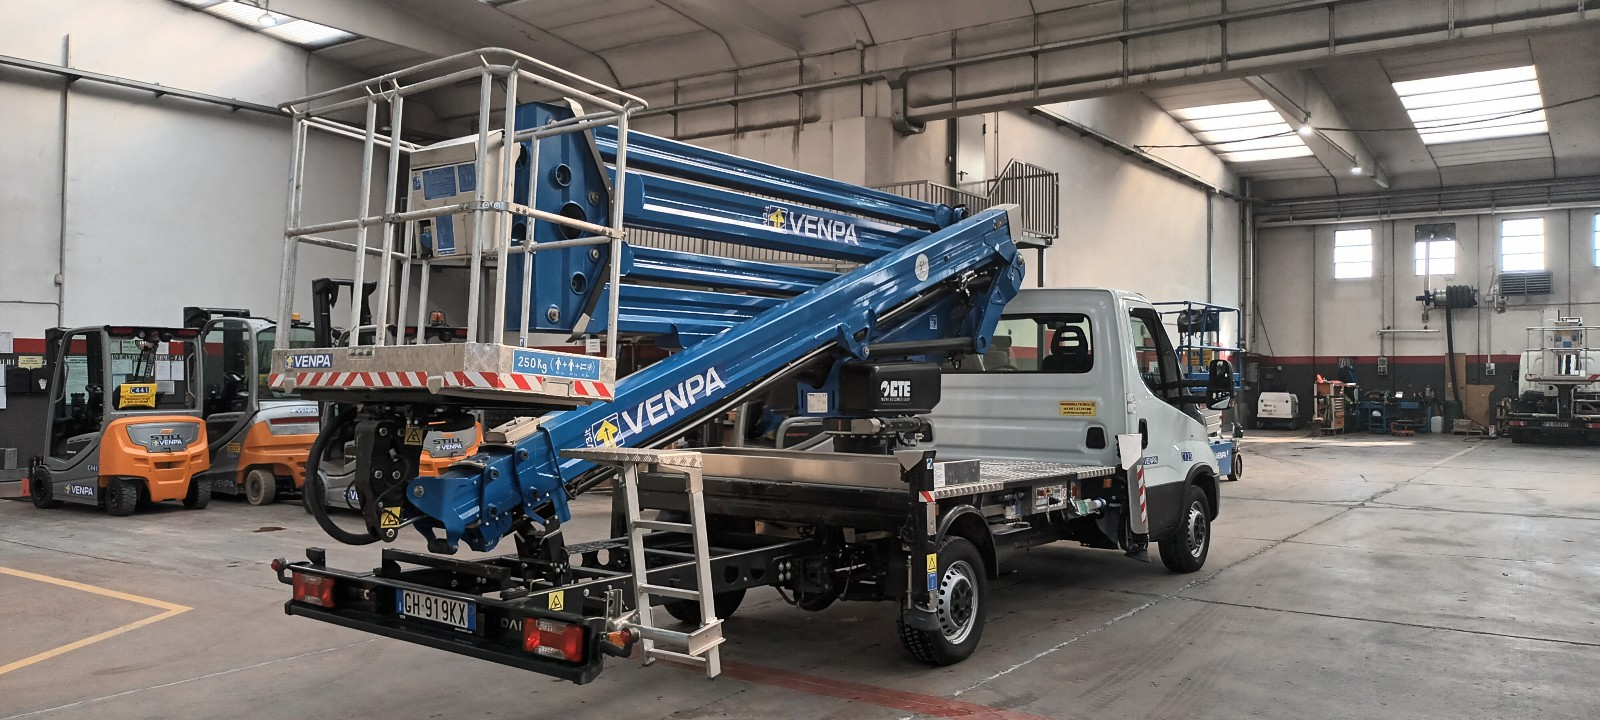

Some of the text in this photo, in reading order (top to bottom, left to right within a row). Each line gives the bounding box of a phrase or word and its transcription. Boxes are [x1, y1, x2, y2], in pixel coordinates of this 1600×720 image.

[789, 211, 860, 246] VENPA
[294, 354, 331, 368] VENPA
[890, 380, 911, 397] CTE
[621, 366, 727, 435] VENPA
[432, 437, 463, 445] STILL
[71, 485, 94, 496] VENPA
